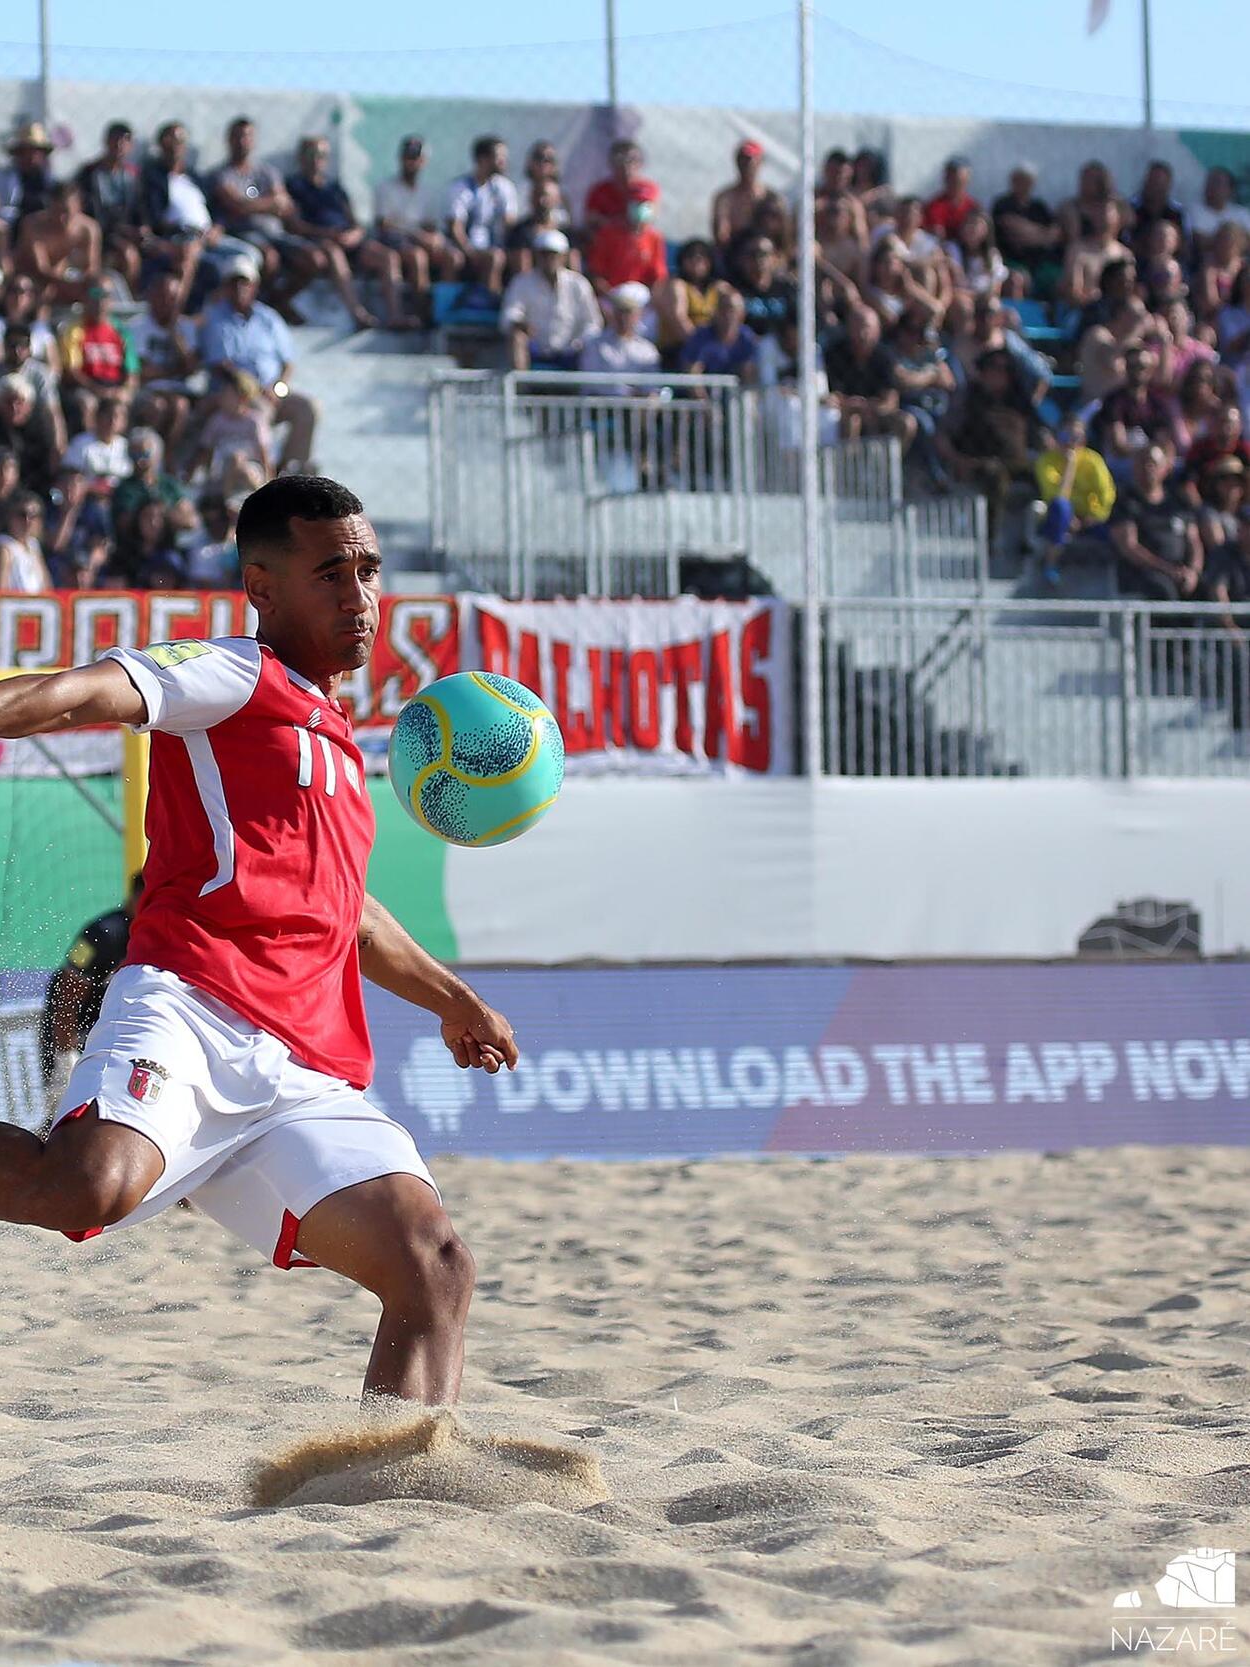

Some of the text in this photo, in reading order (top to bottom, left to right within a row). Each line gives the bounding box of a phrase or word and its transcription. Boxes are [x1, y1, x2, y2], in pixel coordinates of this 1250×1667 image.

[292, 723, 337, 797] 11
[492, 1044, 869, 1114] DOWNLOAD
[870, 1041, 996, 1105] THE
[1004, 1040, 1119, 1103] APP
